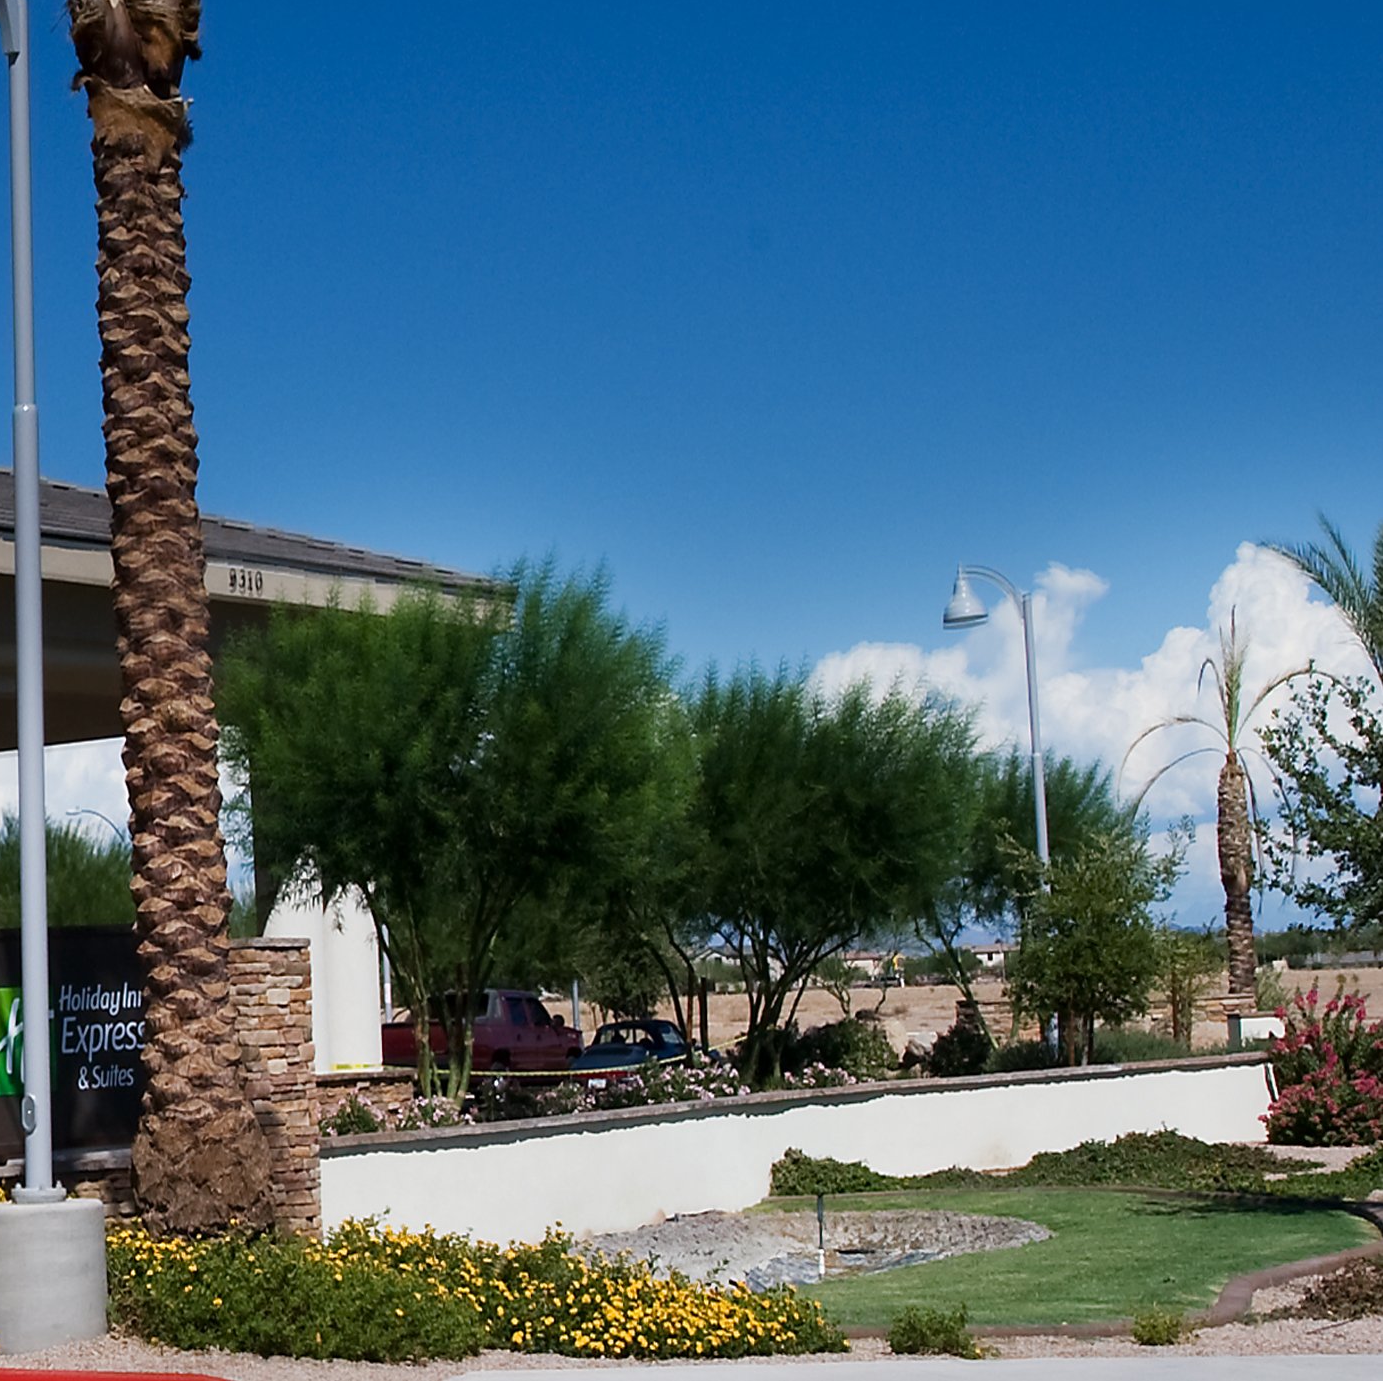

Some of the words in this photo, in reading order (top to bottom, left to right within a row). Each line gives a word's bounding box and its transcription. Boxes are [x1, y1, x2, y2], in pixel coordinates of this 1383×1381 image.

[59, 984, 120, 1016] Holiday
[78, 1066, 89, 1090] &
[92, 1064, 134, 1089] Suites
